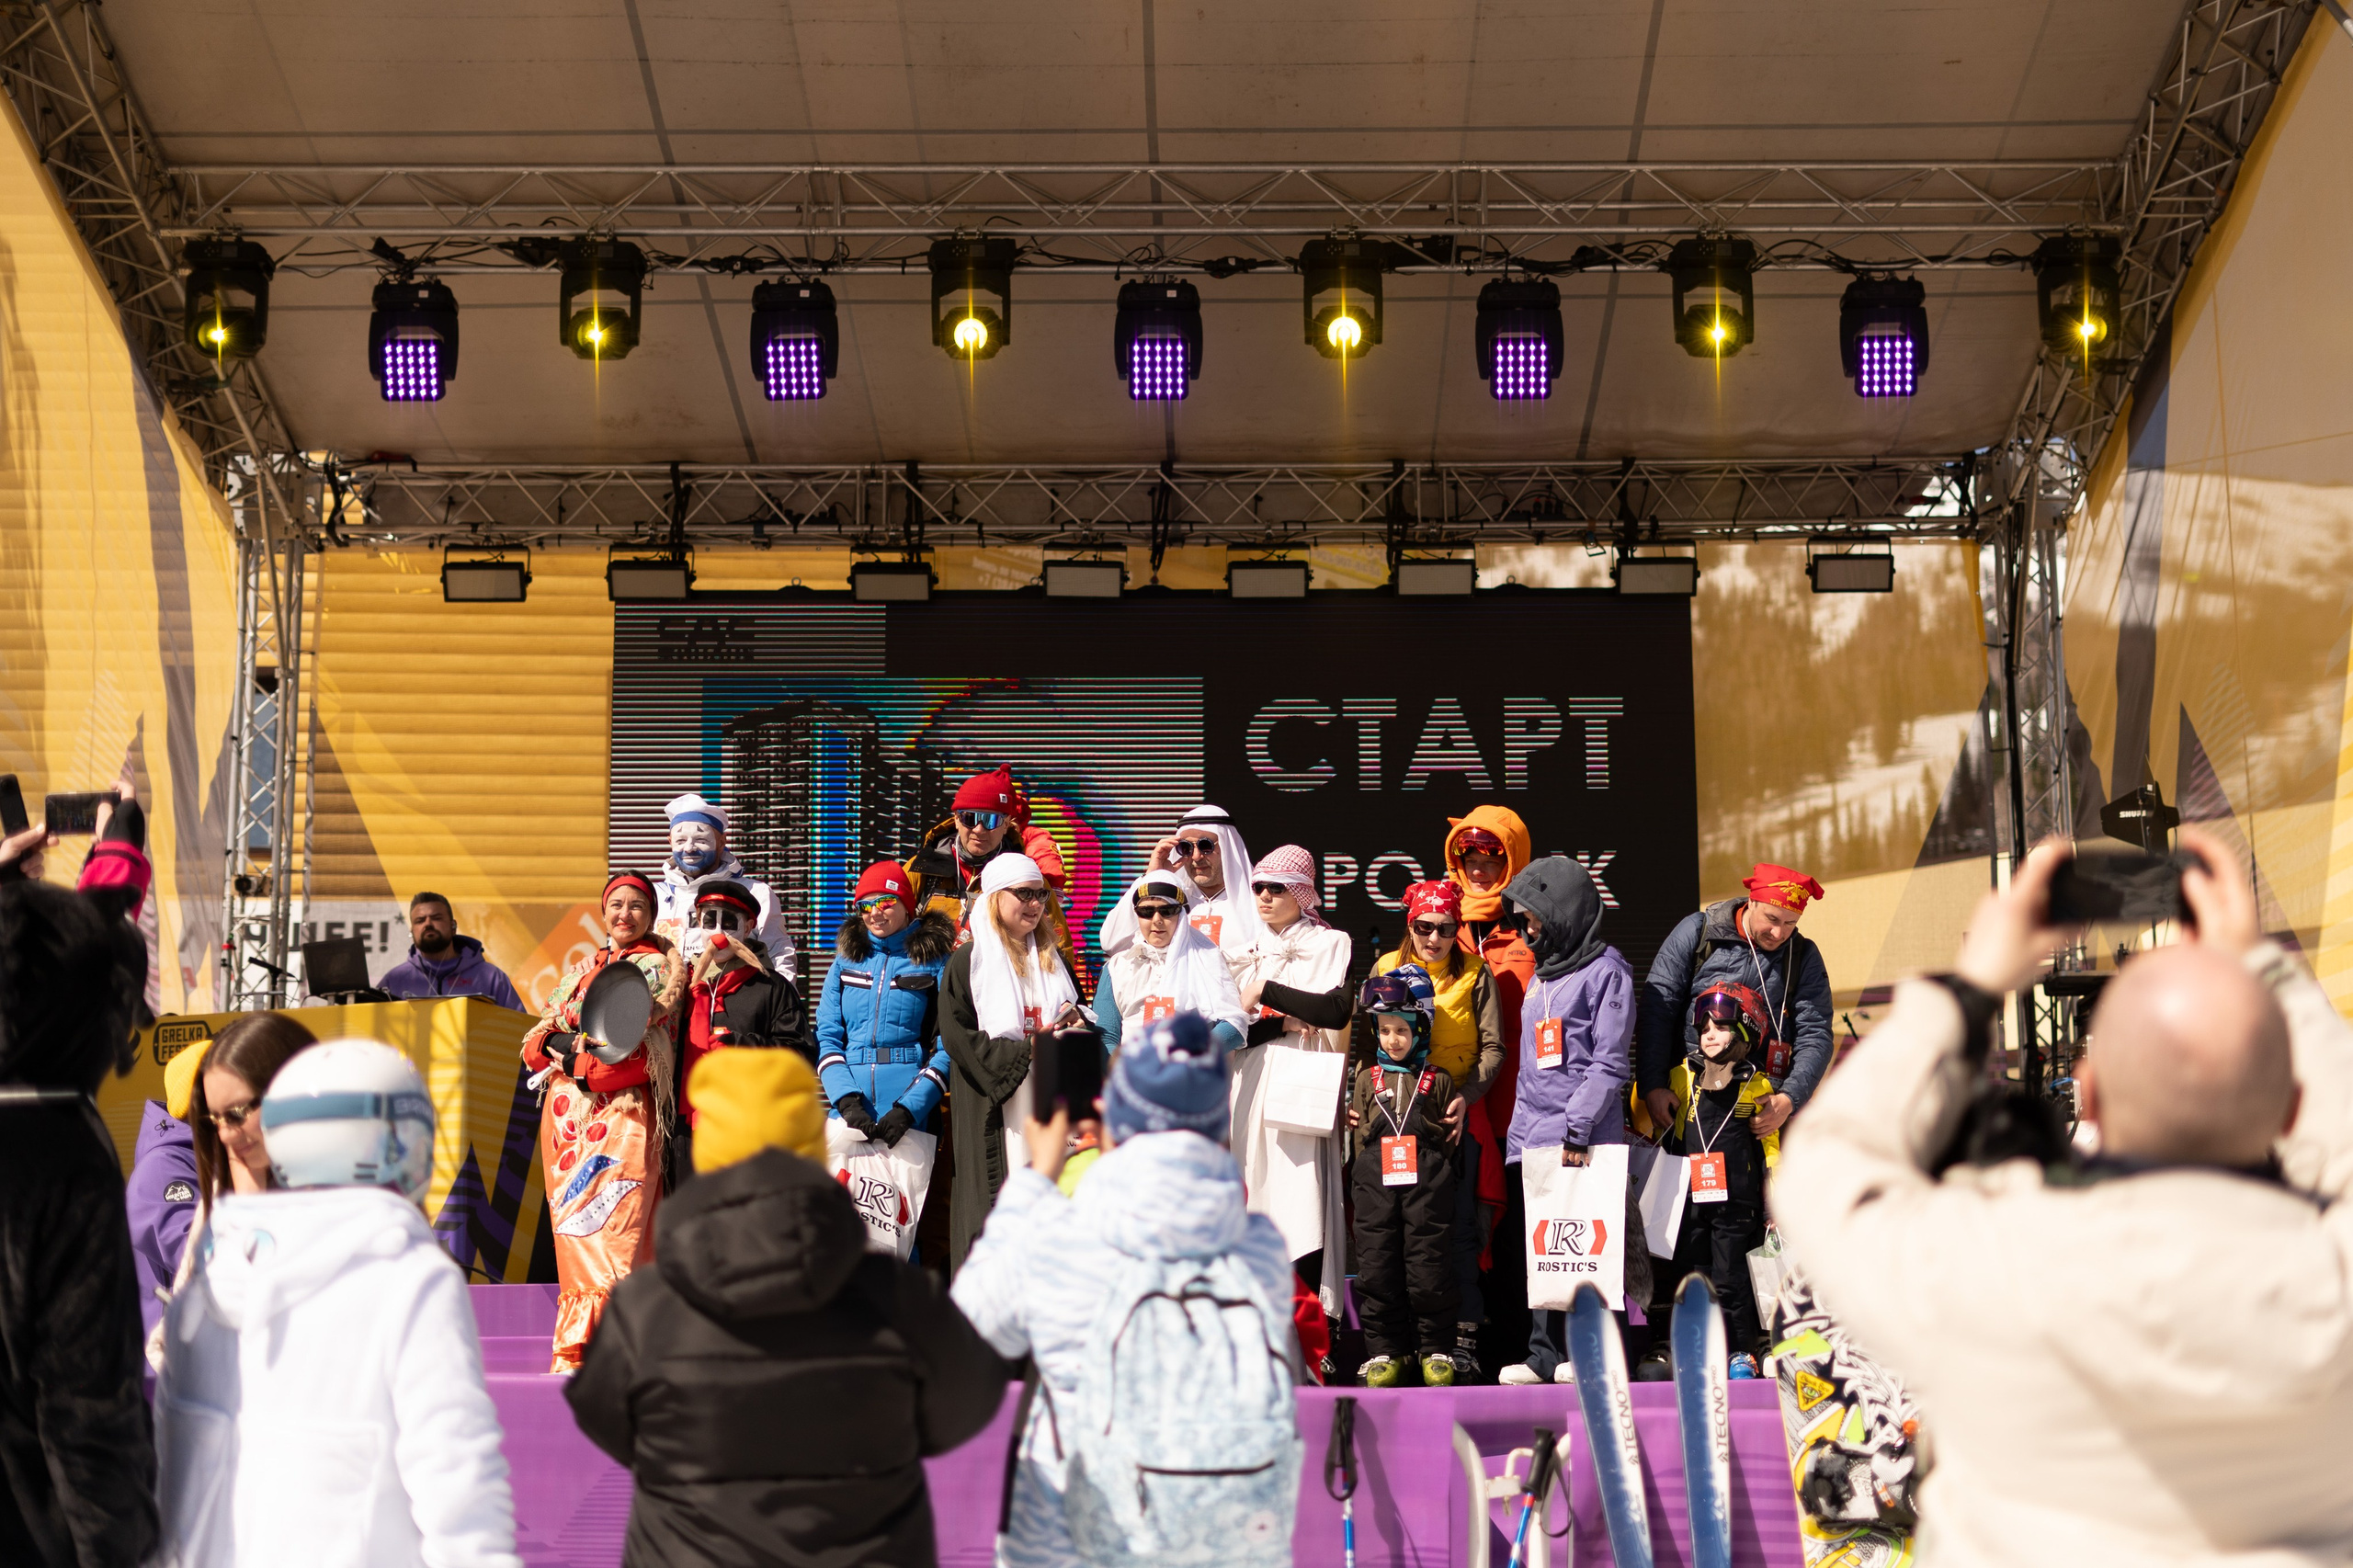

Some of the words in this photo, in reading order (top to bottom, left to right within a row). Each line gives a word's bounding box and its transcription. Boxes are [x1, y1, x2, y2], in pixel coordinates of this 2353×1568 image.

[1245, 698, 1624, 791] СТАРТ
[161, 1027, 203, 1043] GRELKA
[1392, 1162, 1407, 1170] 180
[853, 1176, 895, 1218] R
[1701, 1179, 1717, 1187] 179
[859, 1211, 901, 1238] STIC'S
[1548, 1219, 1587, 1256] R
[1537, 1261, 1598, 1272] ROSTIC'S
[1616, 1390, 1636, 1453] TECNO
[1712, 1386, 1728, 1449] TECNO
